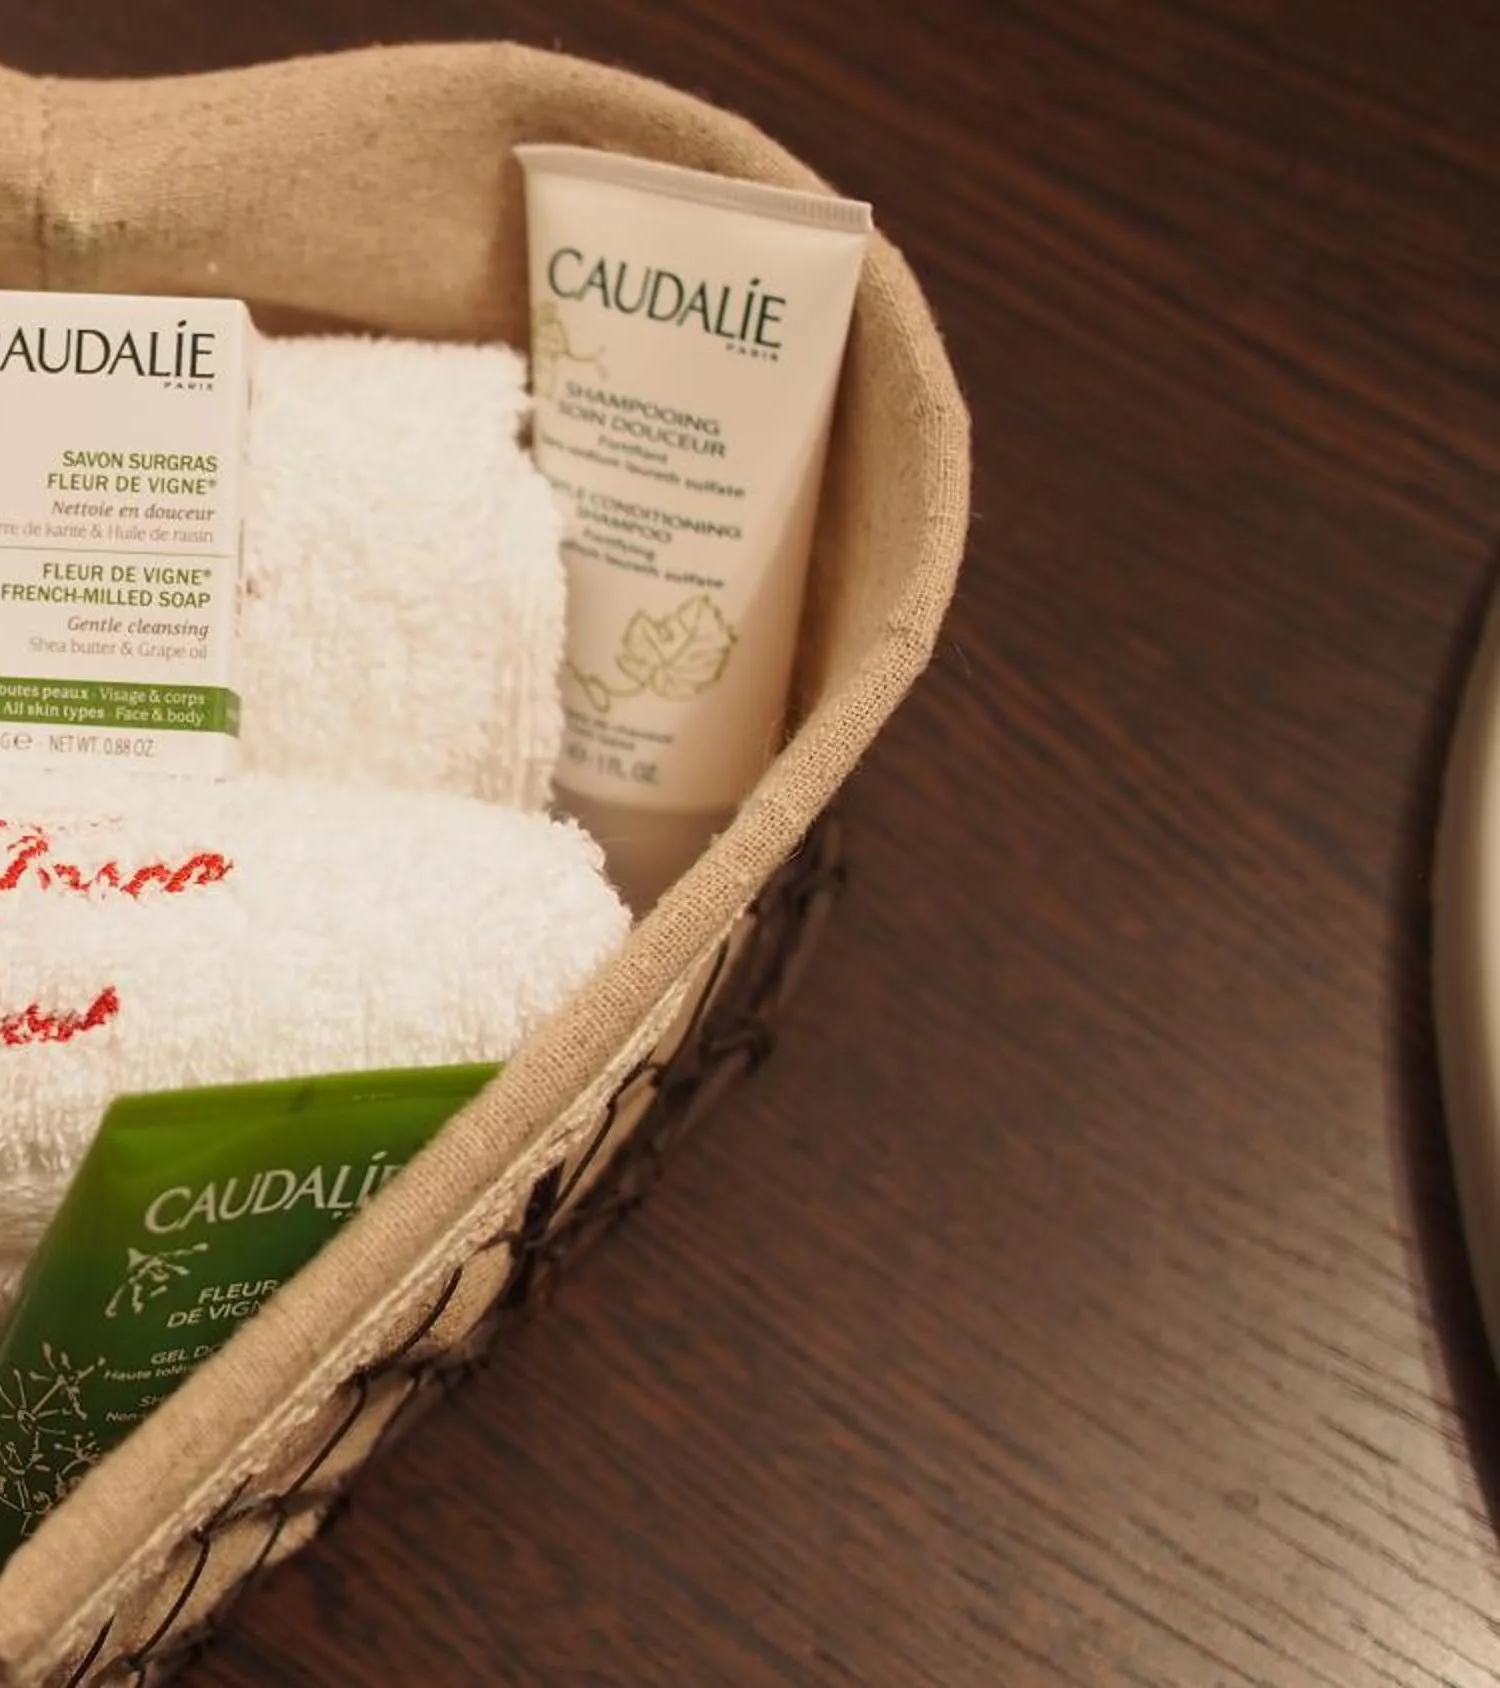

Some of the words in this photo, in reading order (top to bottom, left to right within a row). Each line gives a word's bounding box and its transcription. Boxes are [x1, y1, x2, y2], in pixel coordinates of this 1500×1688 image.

[726, 342, 779, 363] PARIS
[163, 381, 213, 391] PARIS
[566, 381, 720, 436] SHAMPOOING
[559, 400, 606, 425] SOIN
[612, 414, 727, 458] DOUCEUR
[62, 450, 124, 469] SAVON
[128, 452, 218, 473] SURGRAS
[47, 473, 109, 491] FLEUR
[116, 475, 141, 493] DE
[685, 478, 746, 497] sulfate
[51, 500, 114, 517] Nettoie
[119, 505, 140, 518] en
[144, 503, 215, 521] douceur
[589, 491, 742, 540] CONDITIONING
[23, 521, 42, 537] de
[90, 523, 102, 540] &
[150, 527, 171, 542] de
[577, 506, 673, 544] SHAMPOO
[42, 563, 103, 581] FLEUR
[111, 566, 137, 583] DE
[1, 583, 152, 607] FRENCH-MILLED
[159, 591, 211, 609] SOAP
[67, 616, 123, 633] Gentle
[127, 617, 209, 640] cleansing
[29, 637, 66, 654] Shea
[71, 638, 116, 656] butter
[120, 641, 133, 657] &
[138, 641, 183, 661] Grape
[189, 643, 207, 660] oil
[42, 686, 90, 701] peaux
[100, 687, 146, 704] Visage
[150, 689, 161, 703] &
[164, 692, 205, 706] corps
[3, 701, 24, 716] All
[27, 702, 59, 718] skin
[64, 704, 105, 721] types
[115, 705, 149, 720] Face
[151, 706, 164, 721] &
[167, 707, 205, 725] body
[49, 734, 74, 752] NET
[198, 1280, 277, 1304] FLEUR
[167, 1307, 202, 1328] DE
[209, 1301, 261, 1320] VIGN
[151, 1349, 188, 1365] GEL
[104, 1369, 151, 1381] Haute
